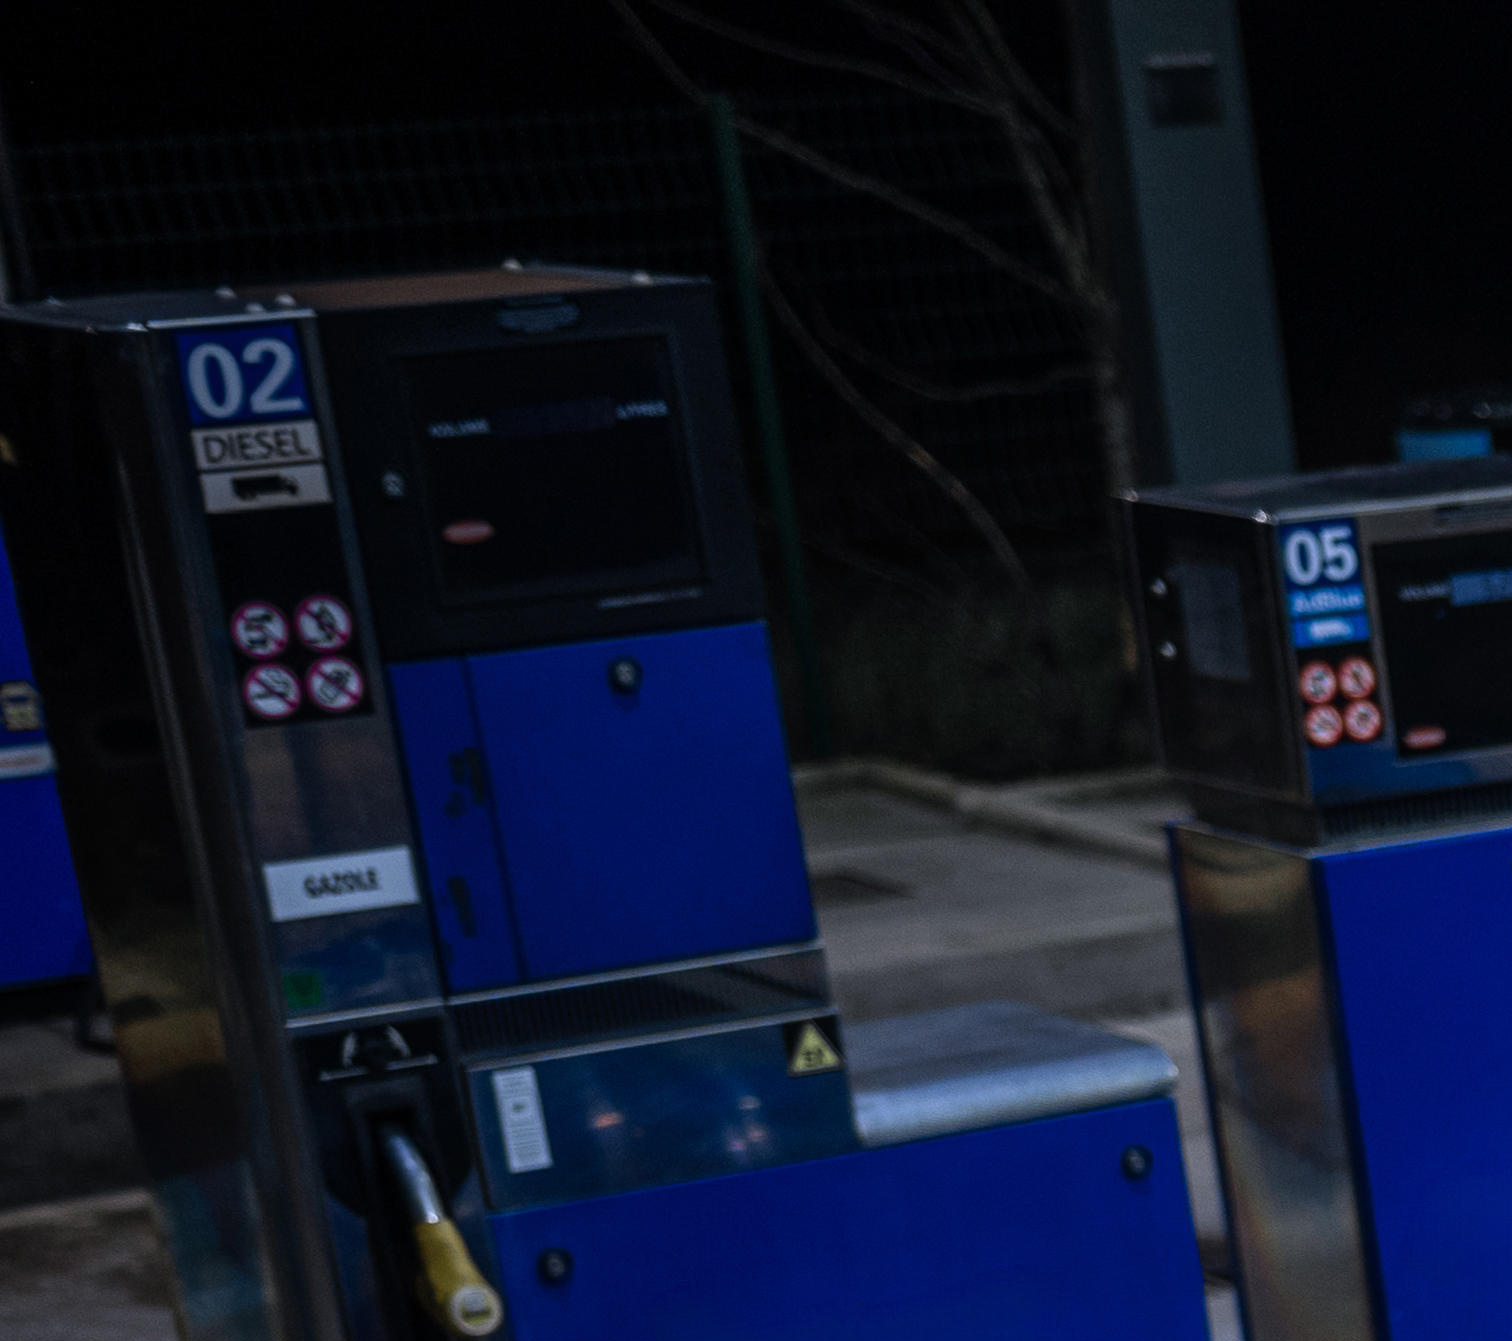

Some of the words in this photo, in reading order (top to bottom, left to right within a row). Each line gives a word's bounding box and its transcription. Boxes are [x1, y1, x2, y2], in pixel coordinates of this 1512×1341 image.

[187, 337, 305, 419] 02
[203, 428, 312, 464] DIESEL
[1285, 525, 1358, 586] 05
